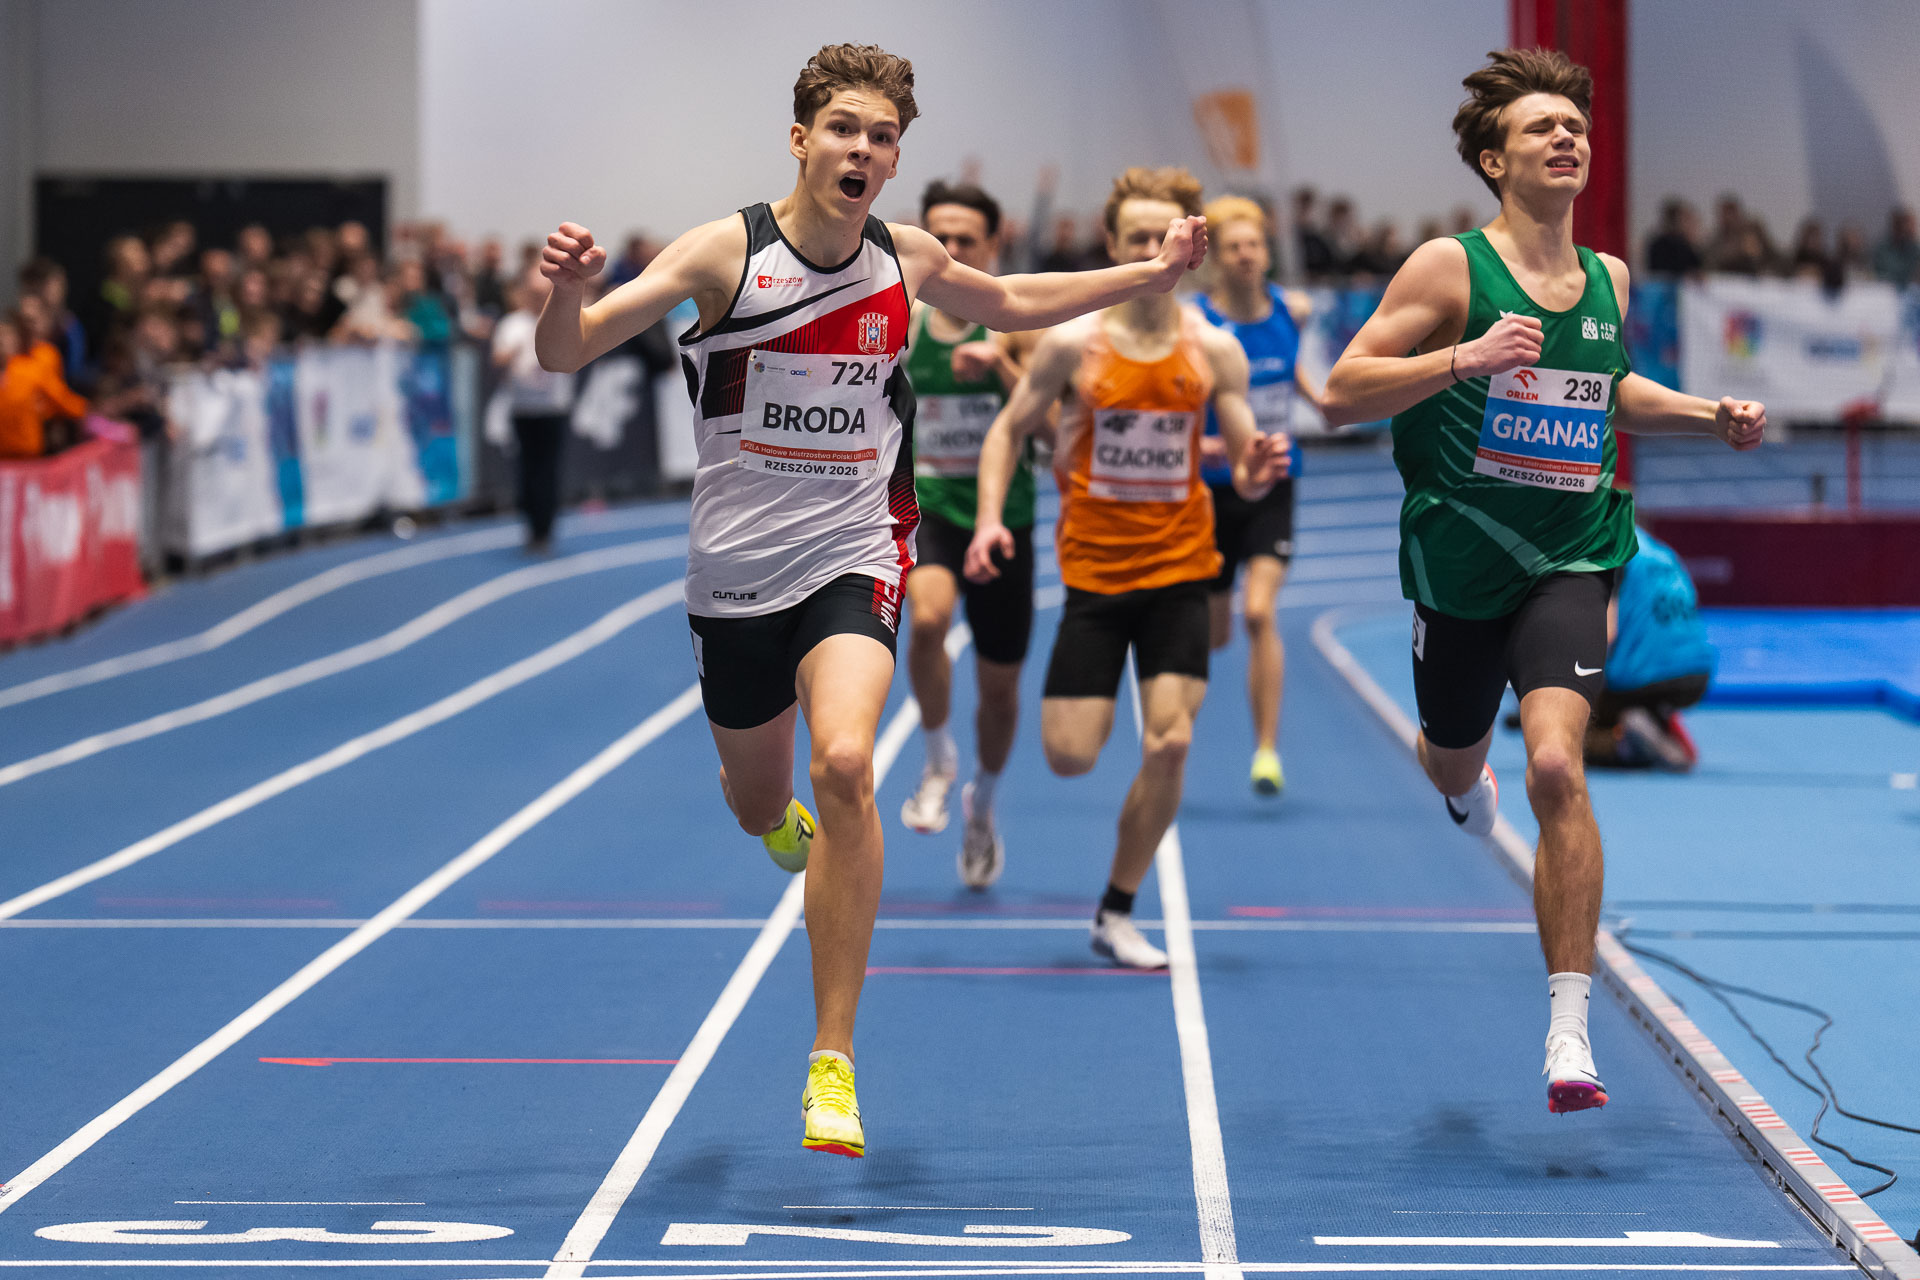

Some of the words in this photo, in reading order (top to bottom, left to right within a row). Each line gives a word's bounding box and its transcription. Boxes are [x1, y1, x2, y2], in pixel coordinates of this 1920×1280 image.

[832, 361, 878, 386] 724
[1506, 389, 1538, 401] ORLEN
[1563, 378, 1603, 403] 238
[762, 402, 866, 434] BRODA
[1492, 413, 1598, 449] GRANAS
[744, 442, 760, 452] PZLA
[761, 445, 788, 456] Halowe
[789, 450, 830, 459] Mistrzostwa
[764, 460, 826, 475] RZESZÓW
[829, 465, 858, 476] 2026
[1523, 459, 1561, 470] Mistrzostwa
[1499, 467, 1556, 485] RZESZÓW
[1559, 476, 1585, 488] 2026
[712, 590, 758, 600] CUTLINE
[34, 1220, 514, 1244] 3
[660, 1223, 1132, 1247] 2
